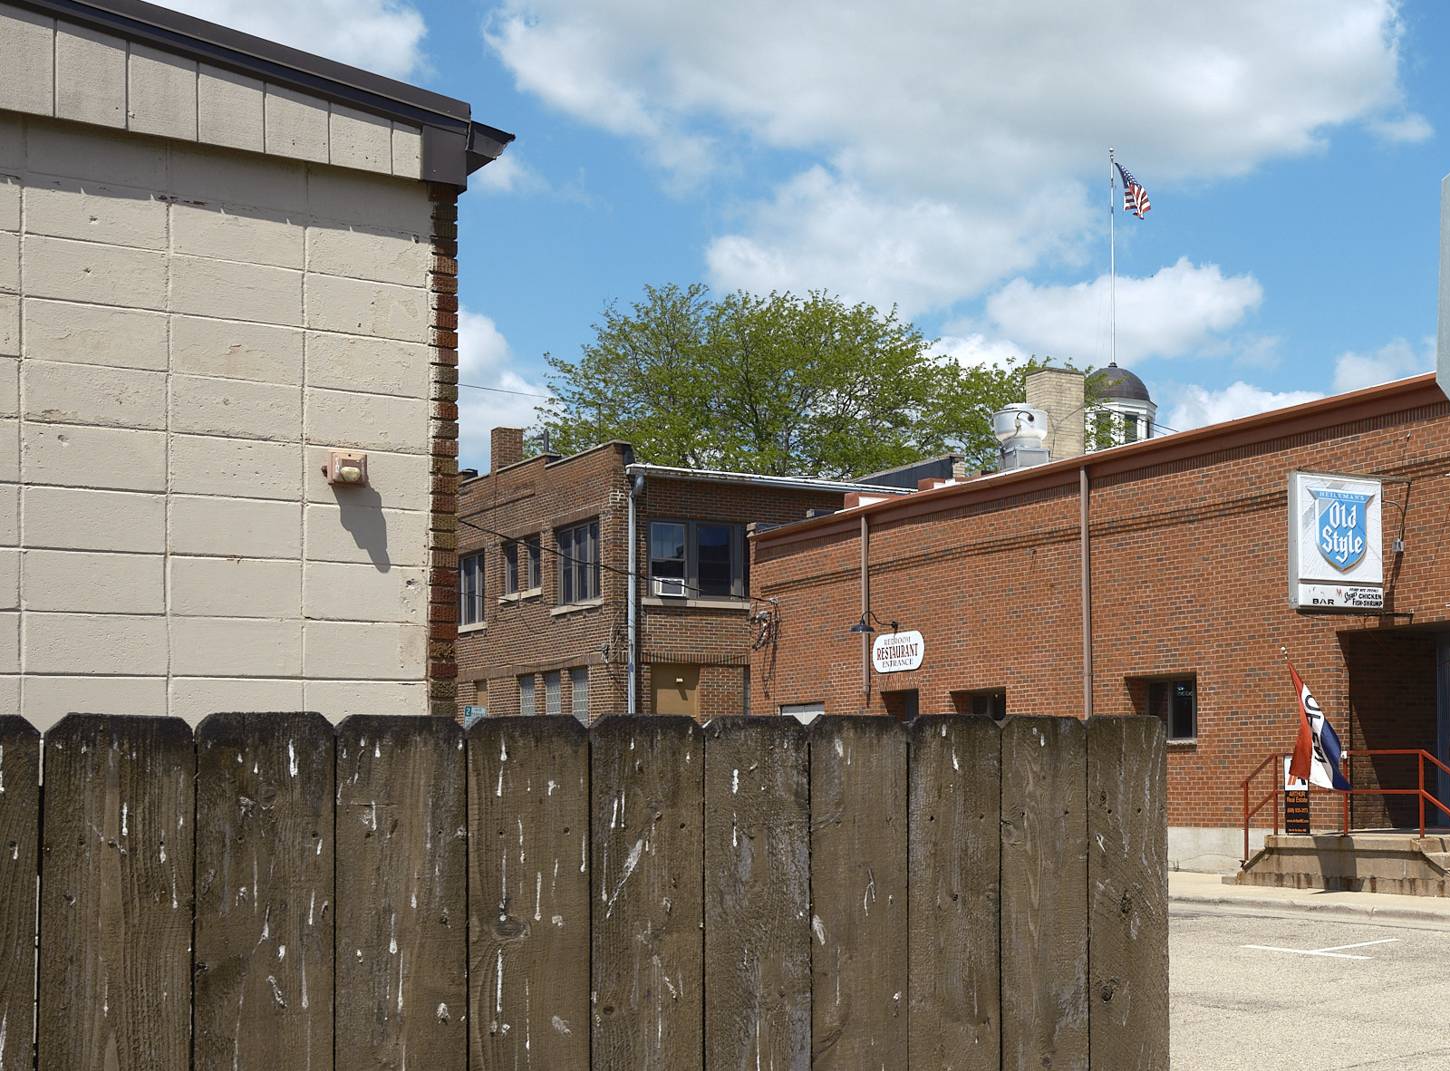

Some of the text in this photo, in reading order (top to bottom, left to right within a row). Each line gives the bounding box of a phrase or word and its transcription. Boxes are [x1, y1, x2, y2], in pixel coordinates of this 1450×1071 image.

[1329, 501, 1357, 529] Old
[1322, 526, 1363, 563] Style
[1312, 598, 1335, 606] BAR
[876, 643, 919, 661] RESTAURANT
[882, 658, 913, 669] ENTRANCE
